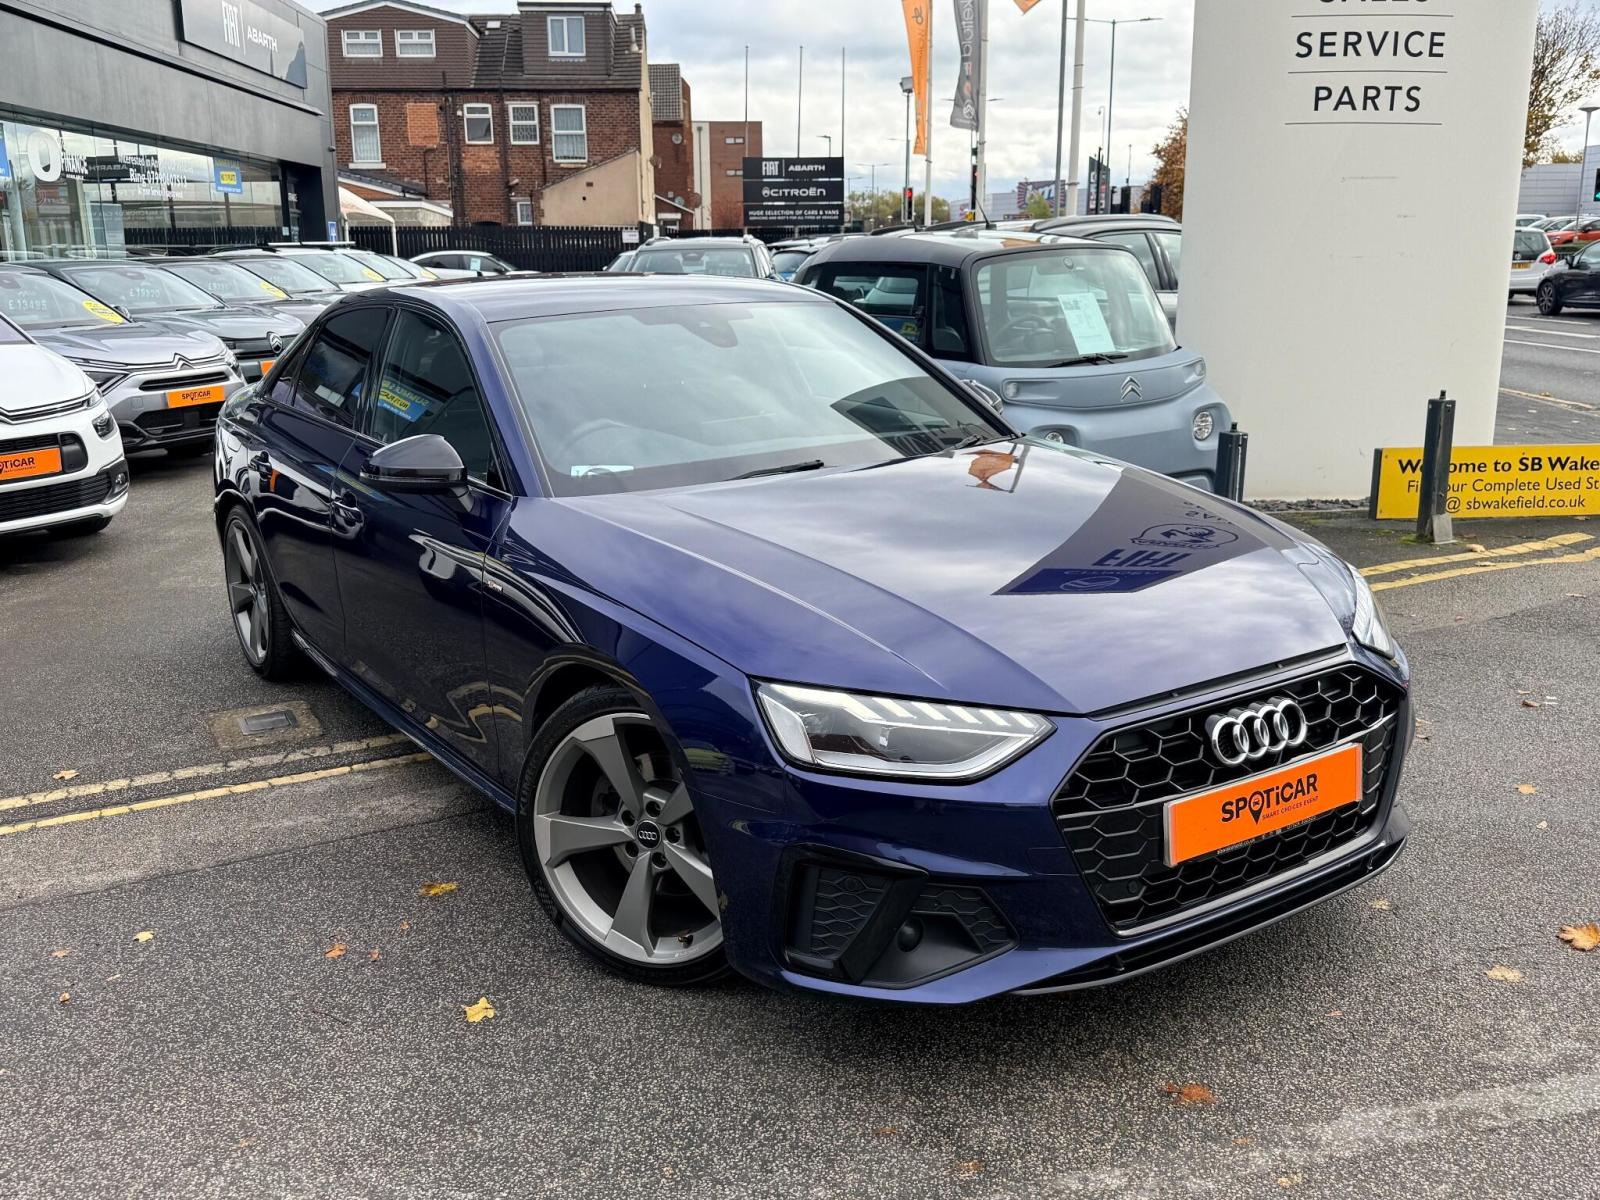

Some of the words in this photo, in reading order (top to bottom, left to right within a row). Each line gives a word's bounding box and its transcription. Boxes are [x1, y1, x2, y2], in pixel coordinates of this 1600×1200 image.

[222, 0, 240, 48] FIAT
[247, 25, 278, 52] ABARTH
[1295, 30, 1446, 58] SERVICE
[1314, 86, 1422, 112] PARTS
[762, 161, 779, 176] FIAT
[788, 164, 825, 172] ABARTH
[1494, 460, 1511, 472] to
[1518, 457, 1542, 472] SB
[1548, 457, 1600, 471] Wake
[1472, 479, 1540, 498] Complete
[1546, 477, 1581, 491] Used
[1466, 495, 1585, 510] sbwakefield.co.uk
[1262, 810, 1280, 820] SMART
